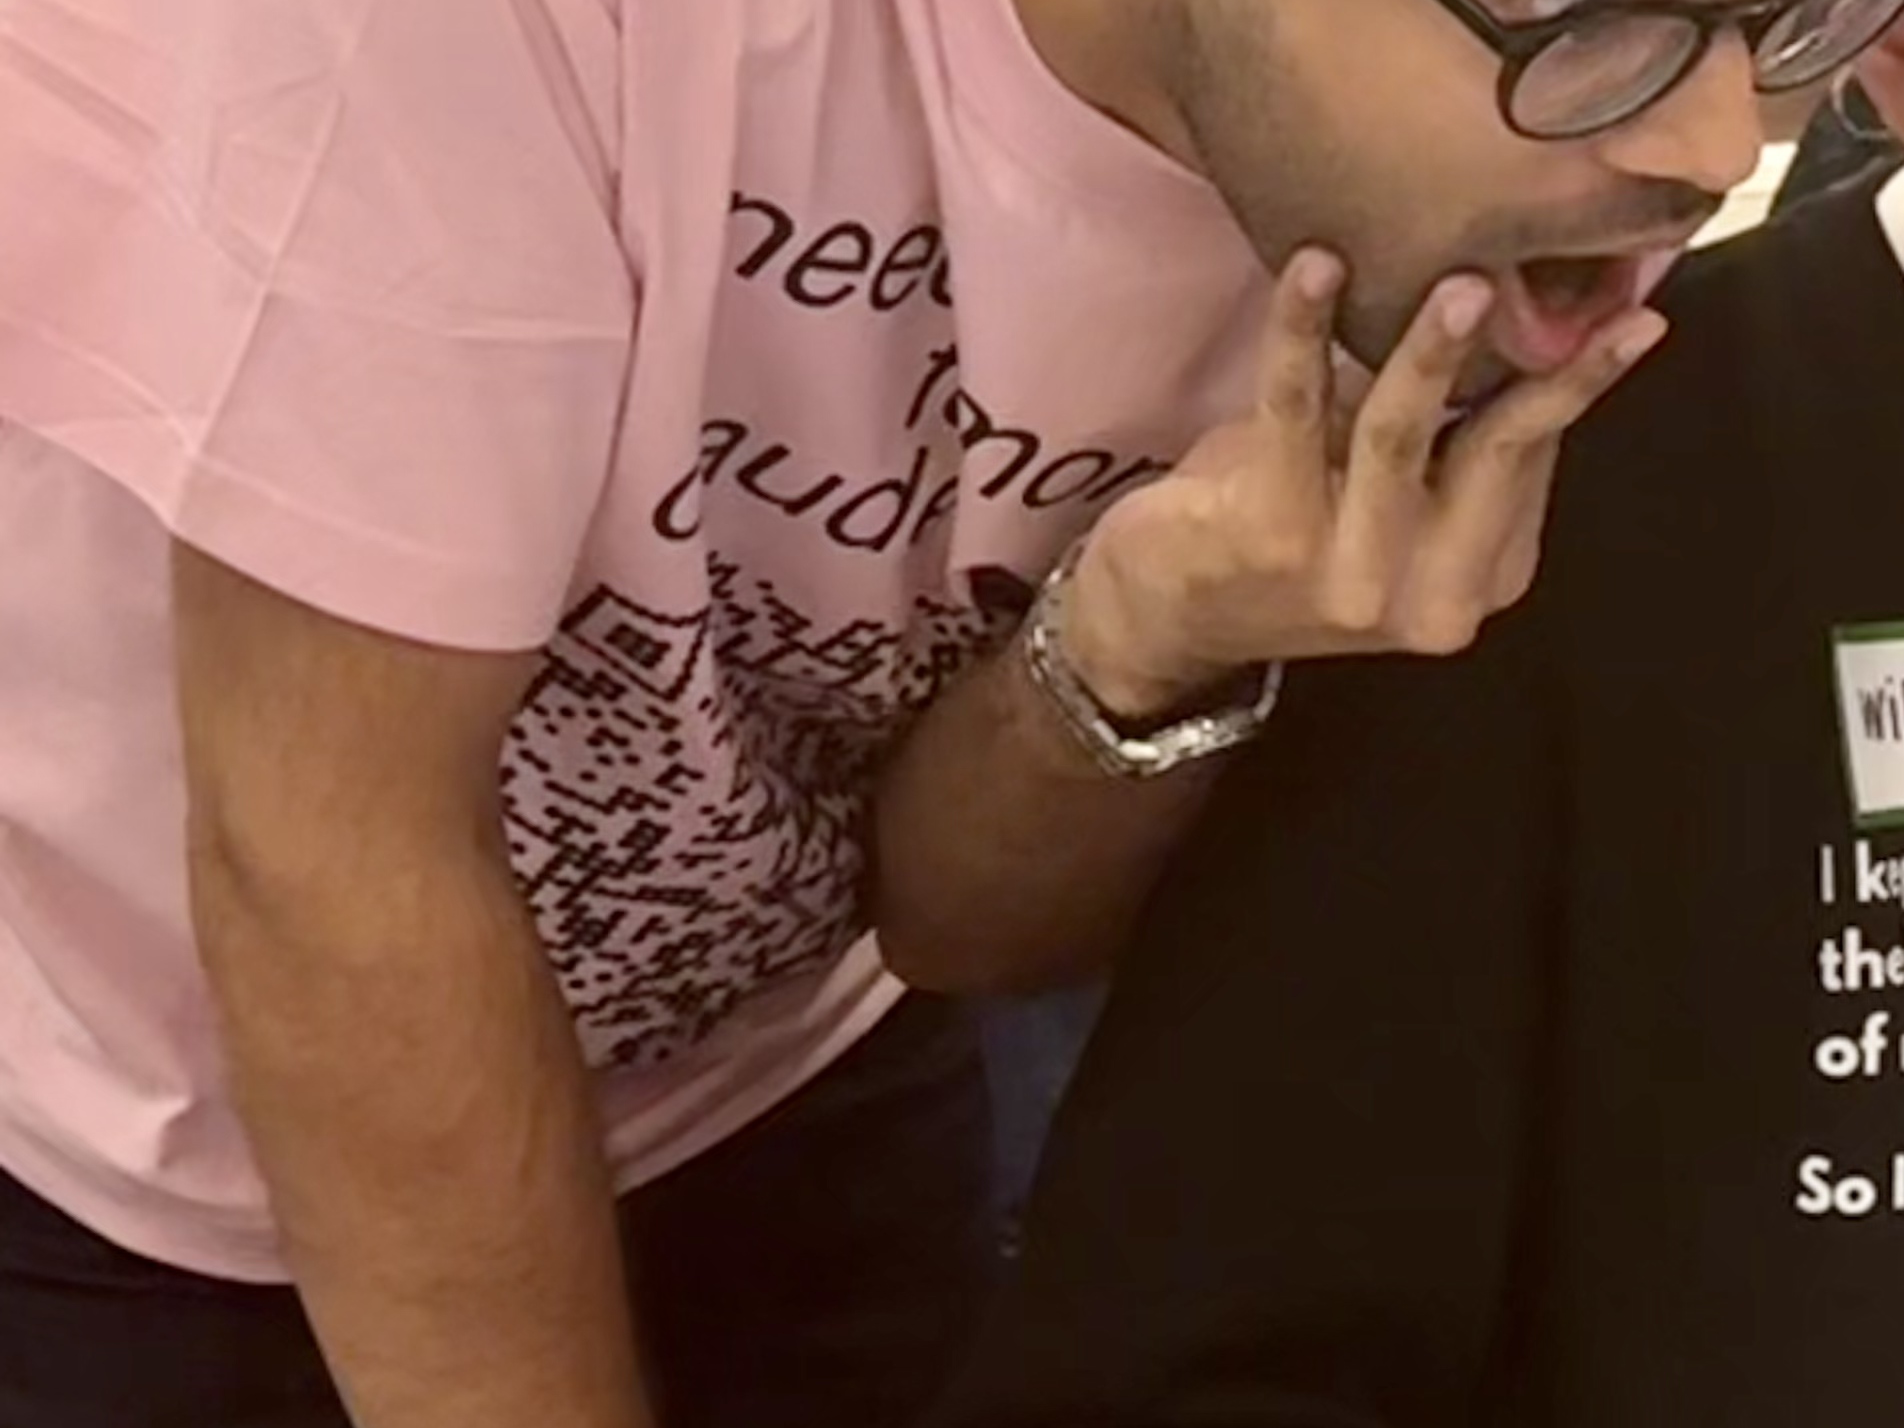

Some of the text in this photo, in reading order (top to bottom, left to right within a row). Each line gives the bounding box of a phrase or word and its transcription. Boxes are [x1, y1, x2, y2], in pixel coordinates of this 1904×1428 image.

[1821, 843, 1836, 903] I
[1815, 1010, 1890, 1079] of
[1795, 1154, 1877, 1215] So
